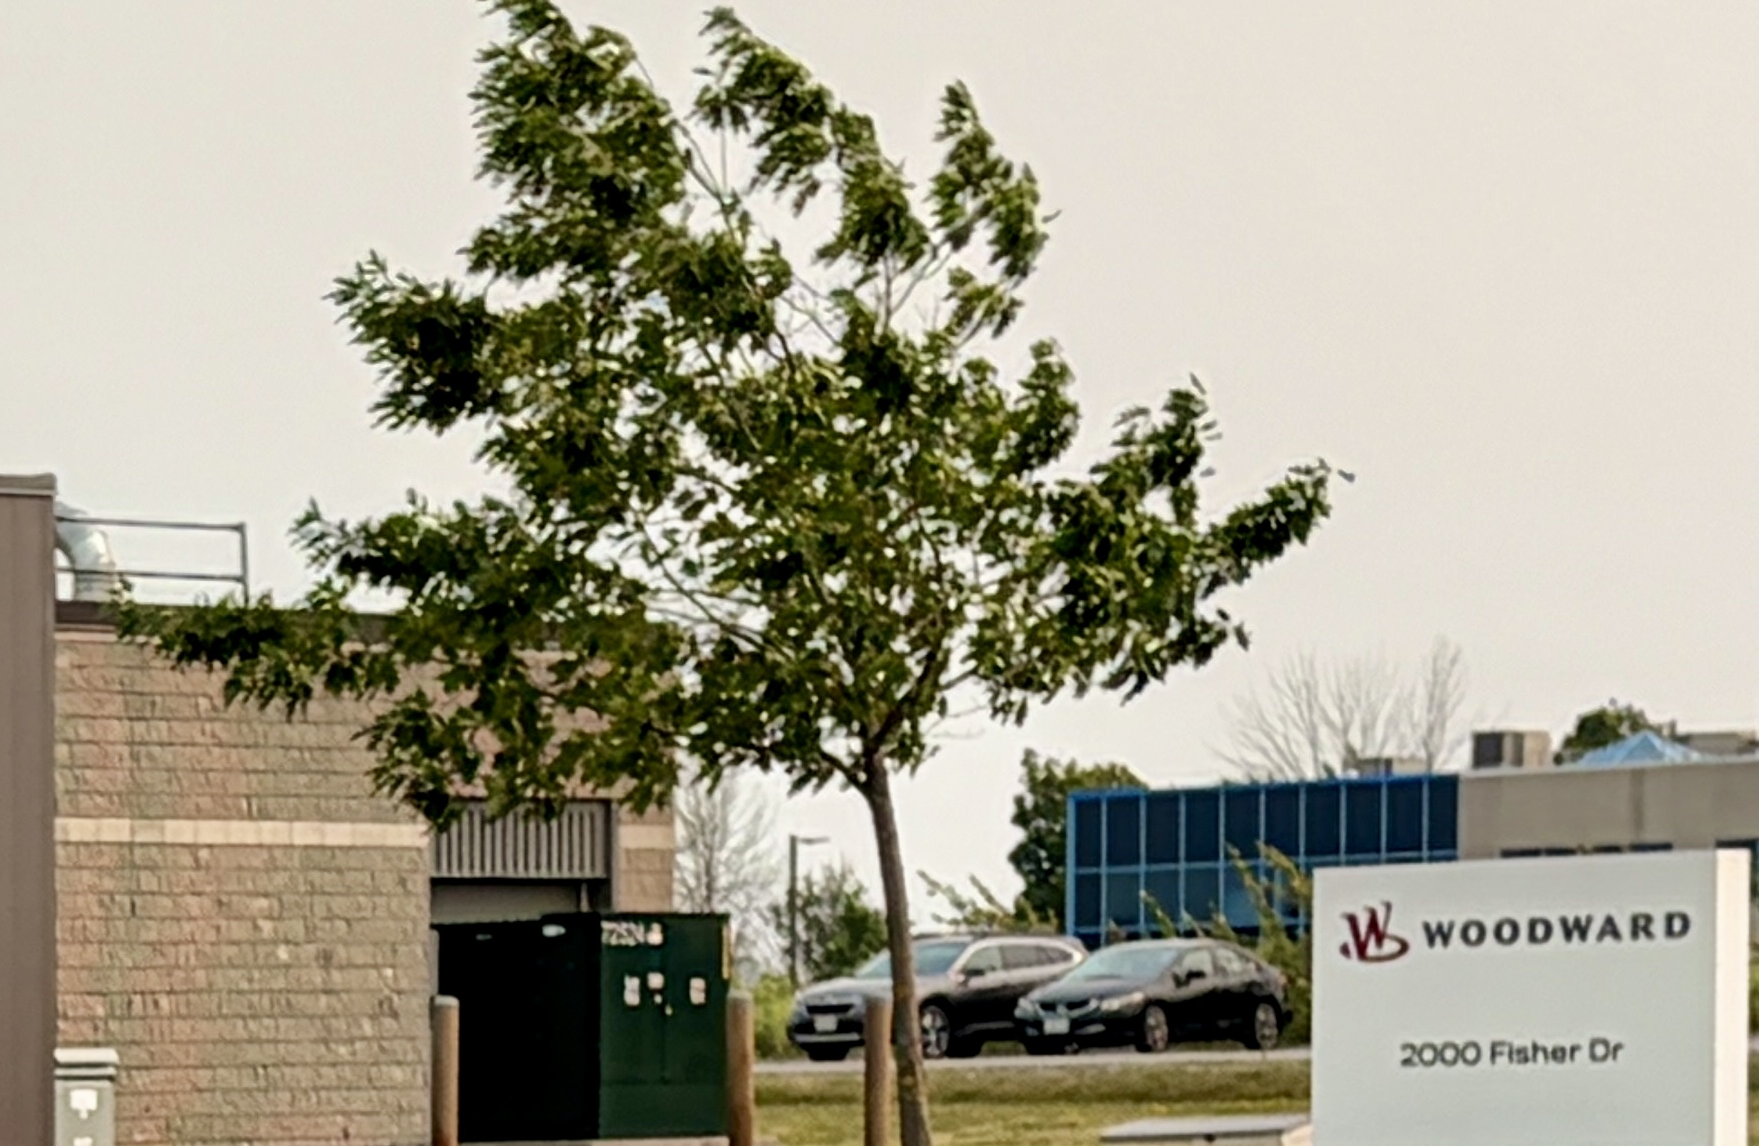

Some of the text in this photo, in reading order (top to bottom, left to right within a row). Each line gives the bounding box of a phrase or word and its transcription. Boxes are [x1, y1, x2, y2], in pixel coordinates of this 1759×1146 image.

[1422, 911, 1691, 948] WOODWARD
[1400, 1037, 1625, 1068] 2000 Fisher Dr
